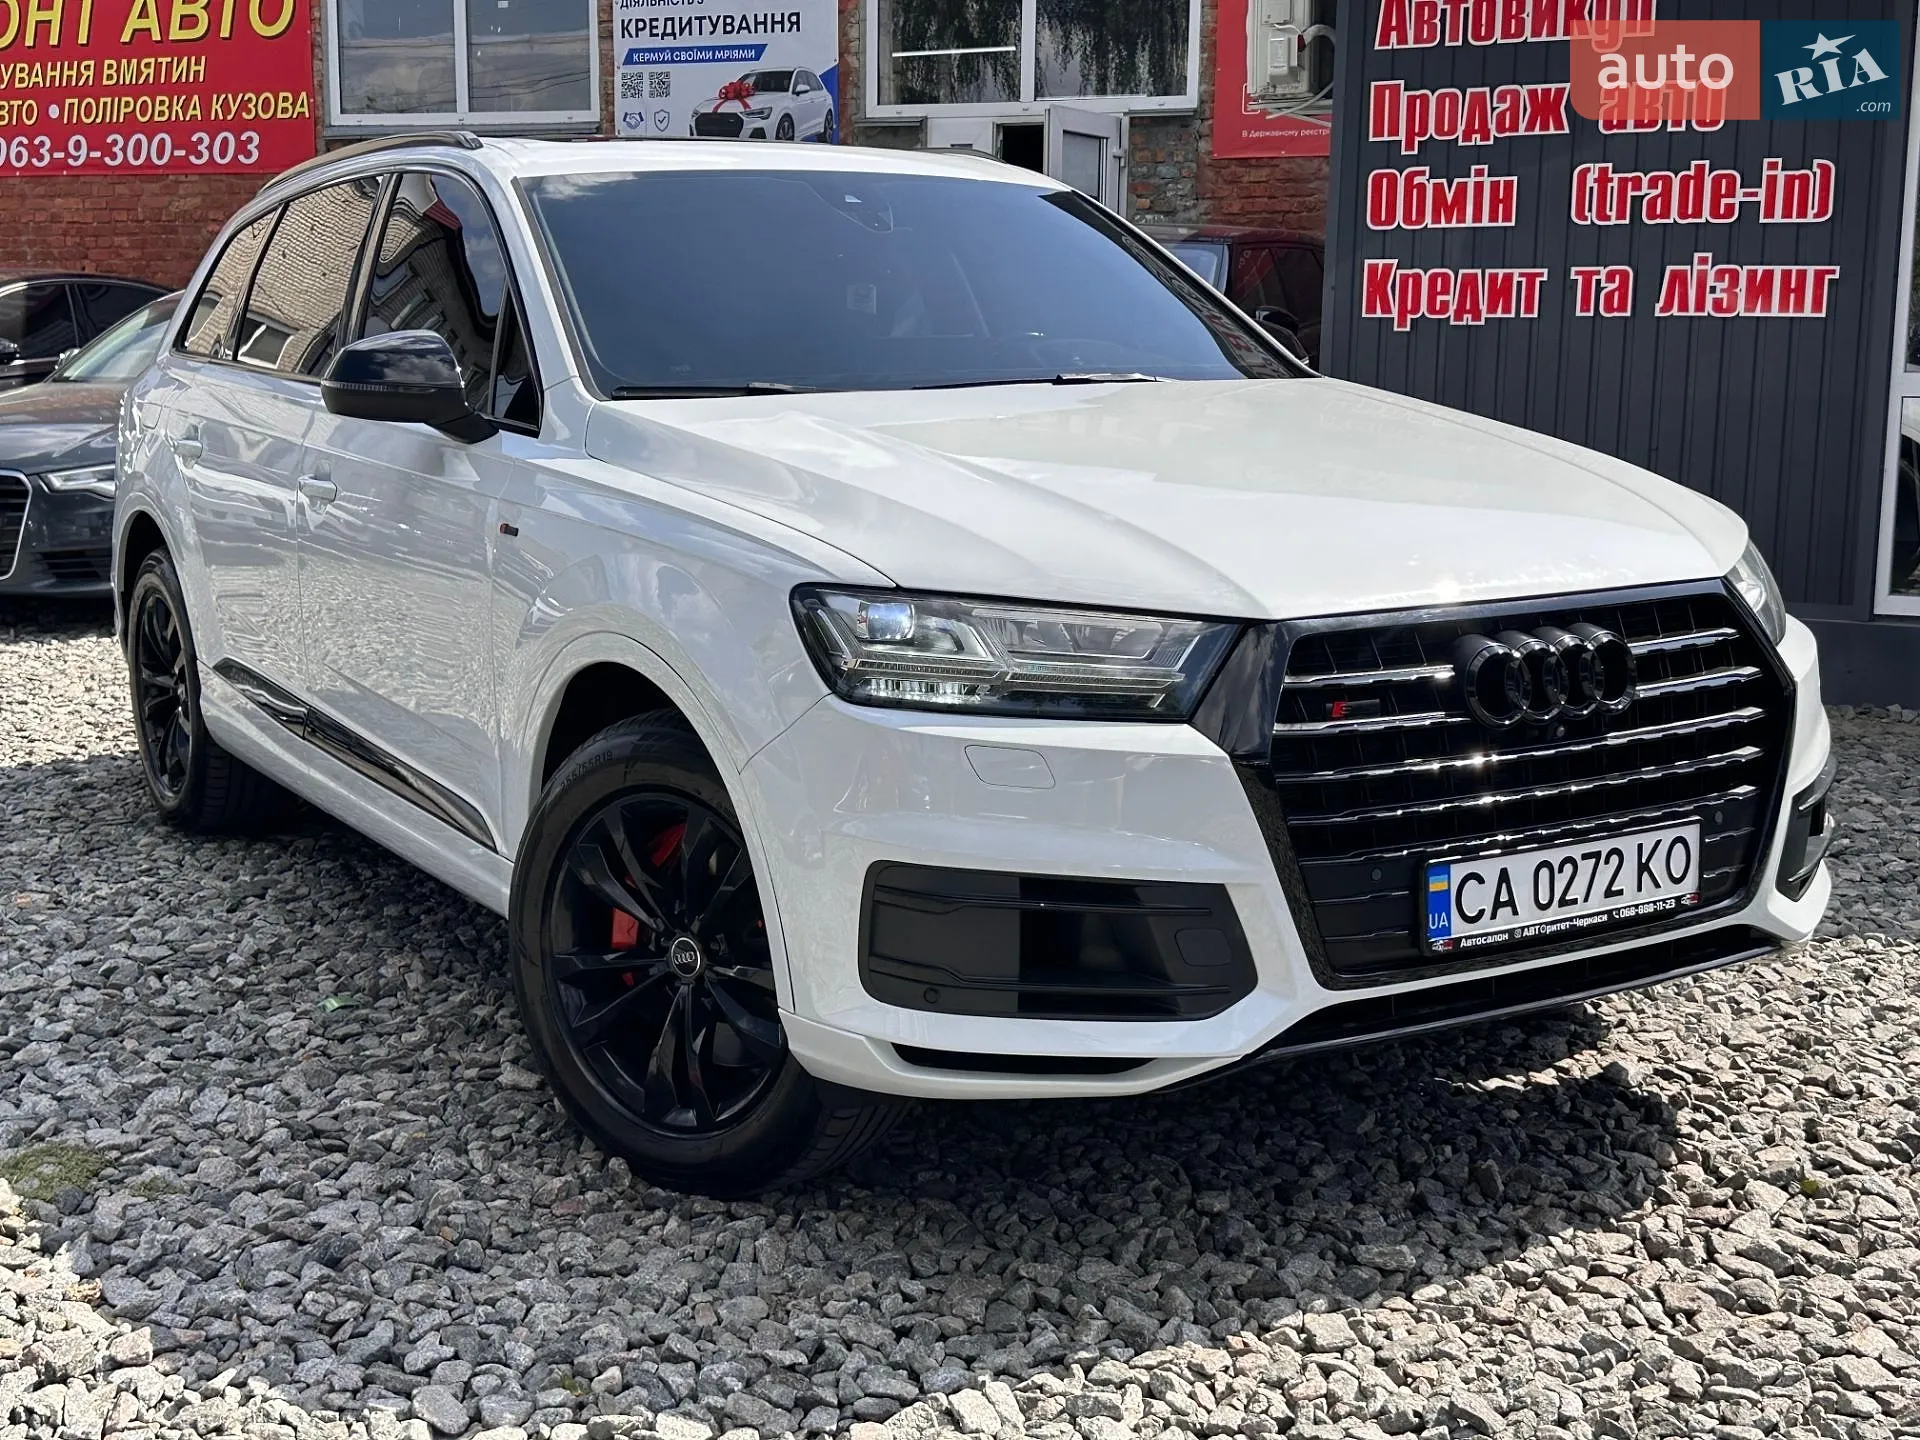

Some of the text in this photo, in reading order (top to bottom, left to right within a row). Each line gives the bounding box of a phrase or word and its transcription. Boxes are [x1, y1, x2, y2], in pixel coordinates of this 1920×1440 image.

[621, 12, 801, 40] КРЕДИТУВАННЯ
[102, 55, 207, 86] ВМЯТИН
[632, 48, 755, 63] КЕРМУЙ СВОЇМИ МРІЯМИ
[63, 94, 202, 125] ПОЛІРОВКА
[210, 91, 310, 121] КУЗОВА
[1368, 78, 1726, 155] Продаж авто
[1366, 164, 1518, 230] Обмін
[1570, 158, 1837, 226] (trade-in)
[1361, 252, 1841, 332] Кредит та лізинг
[1454, 835, 1692, 925] CA 0272 KO
[1428, 911, 1449, 930] UA
[1459, 932, 1510, 948] Автосалон
